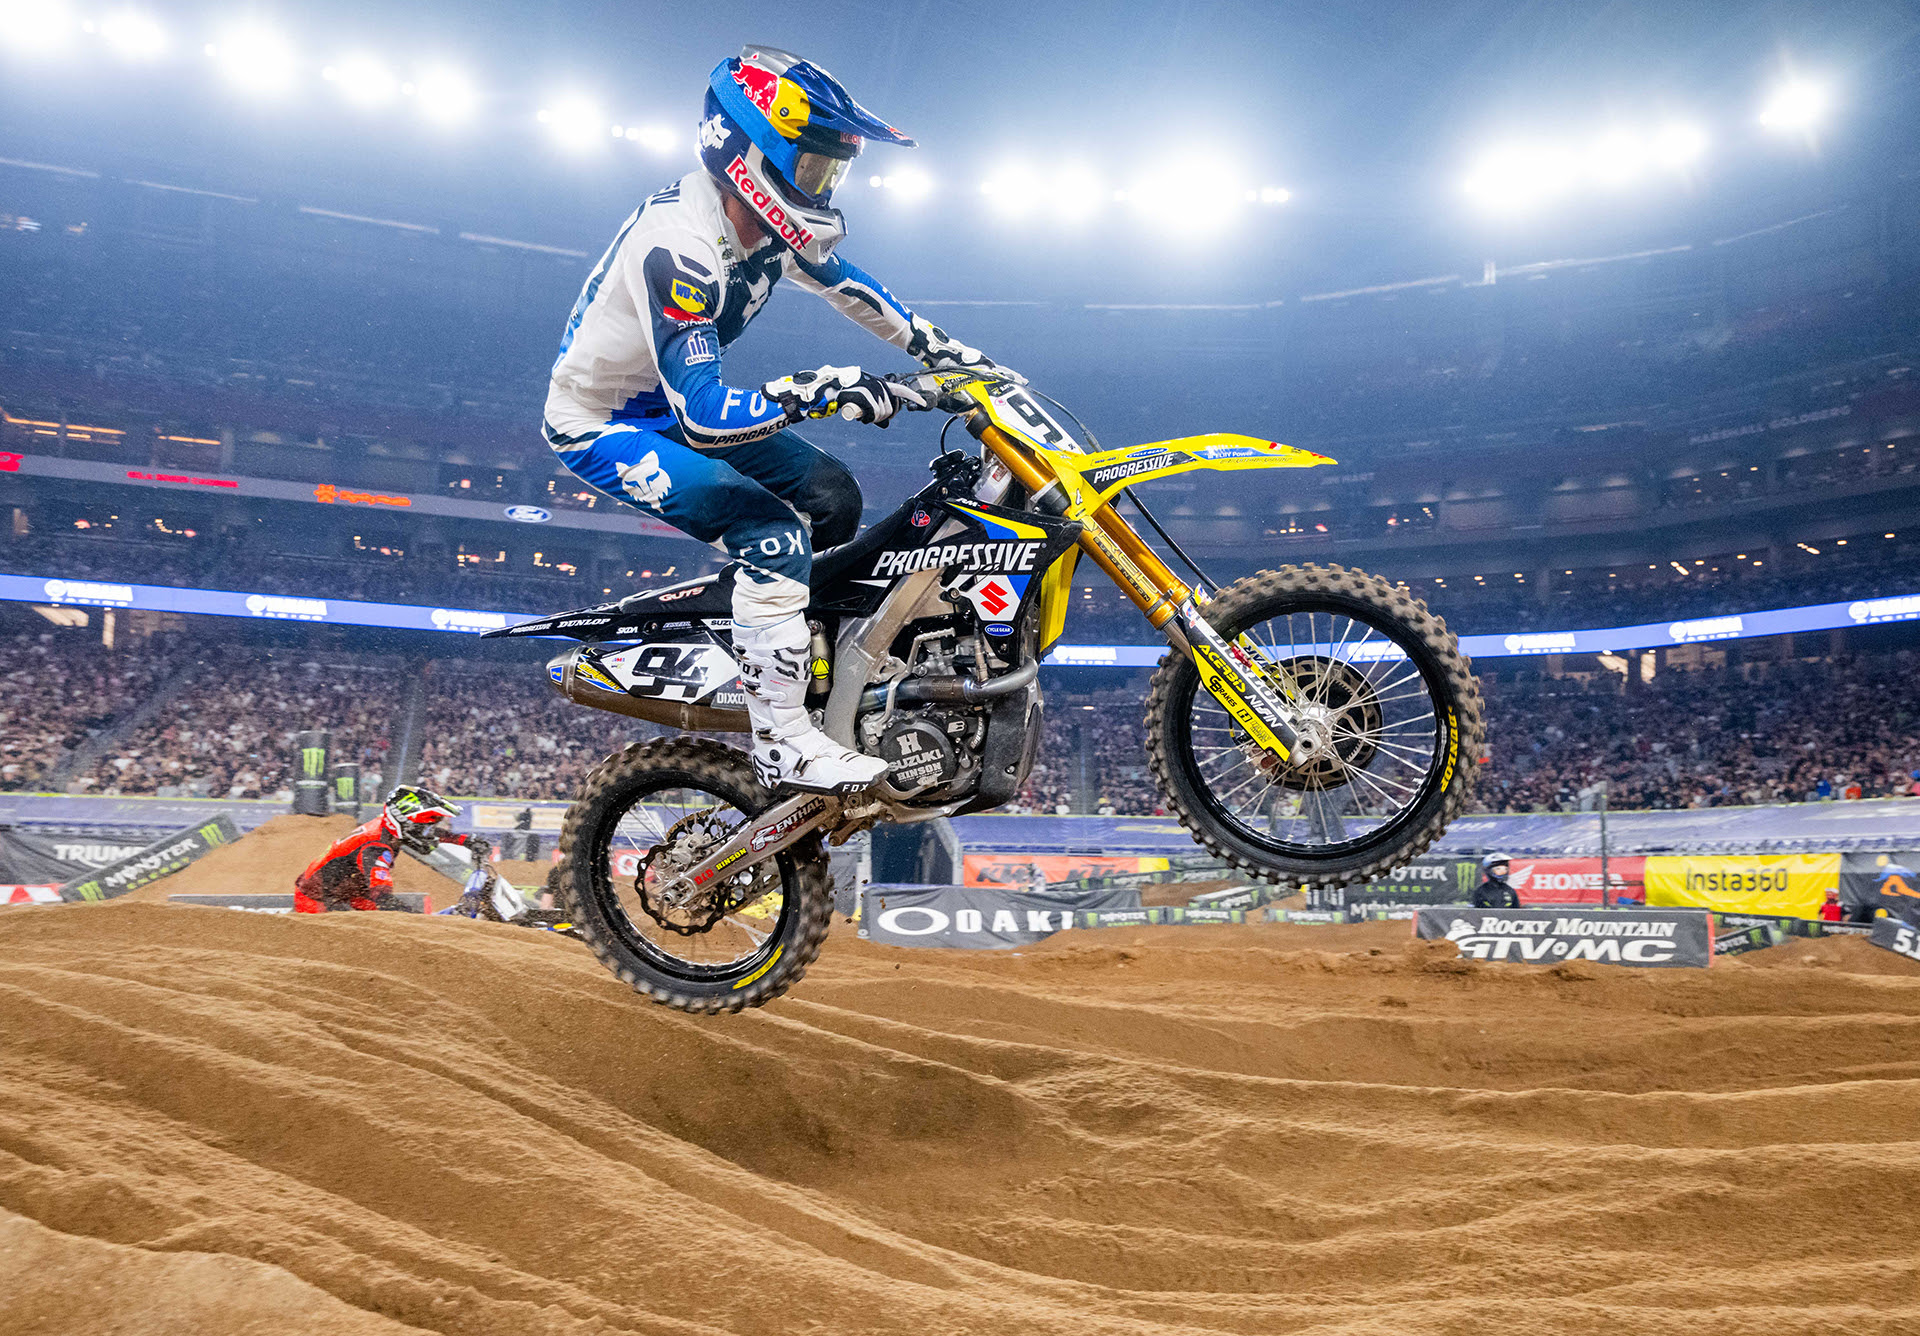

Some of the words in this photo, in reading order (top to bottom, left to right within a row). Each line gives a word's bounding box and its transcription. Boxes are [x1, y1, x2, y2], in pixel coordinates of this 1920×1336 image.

[726, 156, 772, 211] Red
[766, 203, 815, 251] Bull
[720, 388, 782, 420] FO
[1094, 453, 1174, 484] PROGRESSIVE
[872, 542, 1041, 577] PROGRESSIVE
[659, 586, 705, 602] GUTS
[556, 618, 611, 628] DUNLOP
[629, 646, 710, 698] 94
[888, 748, 944, 772] SUZUKI
[1440, 713, 1459, 793] DUNLOP
[896, 762, 942, 780] HINSON
[842, 783, 869, 792] FOX
[716, 848, 747, 870] HINSON
[1686, 867, 1789, 892] Insta360
[1477, 916, 1551, 935] ROCKY
[1551, 917, 1678, 937] MOUNTAIN
